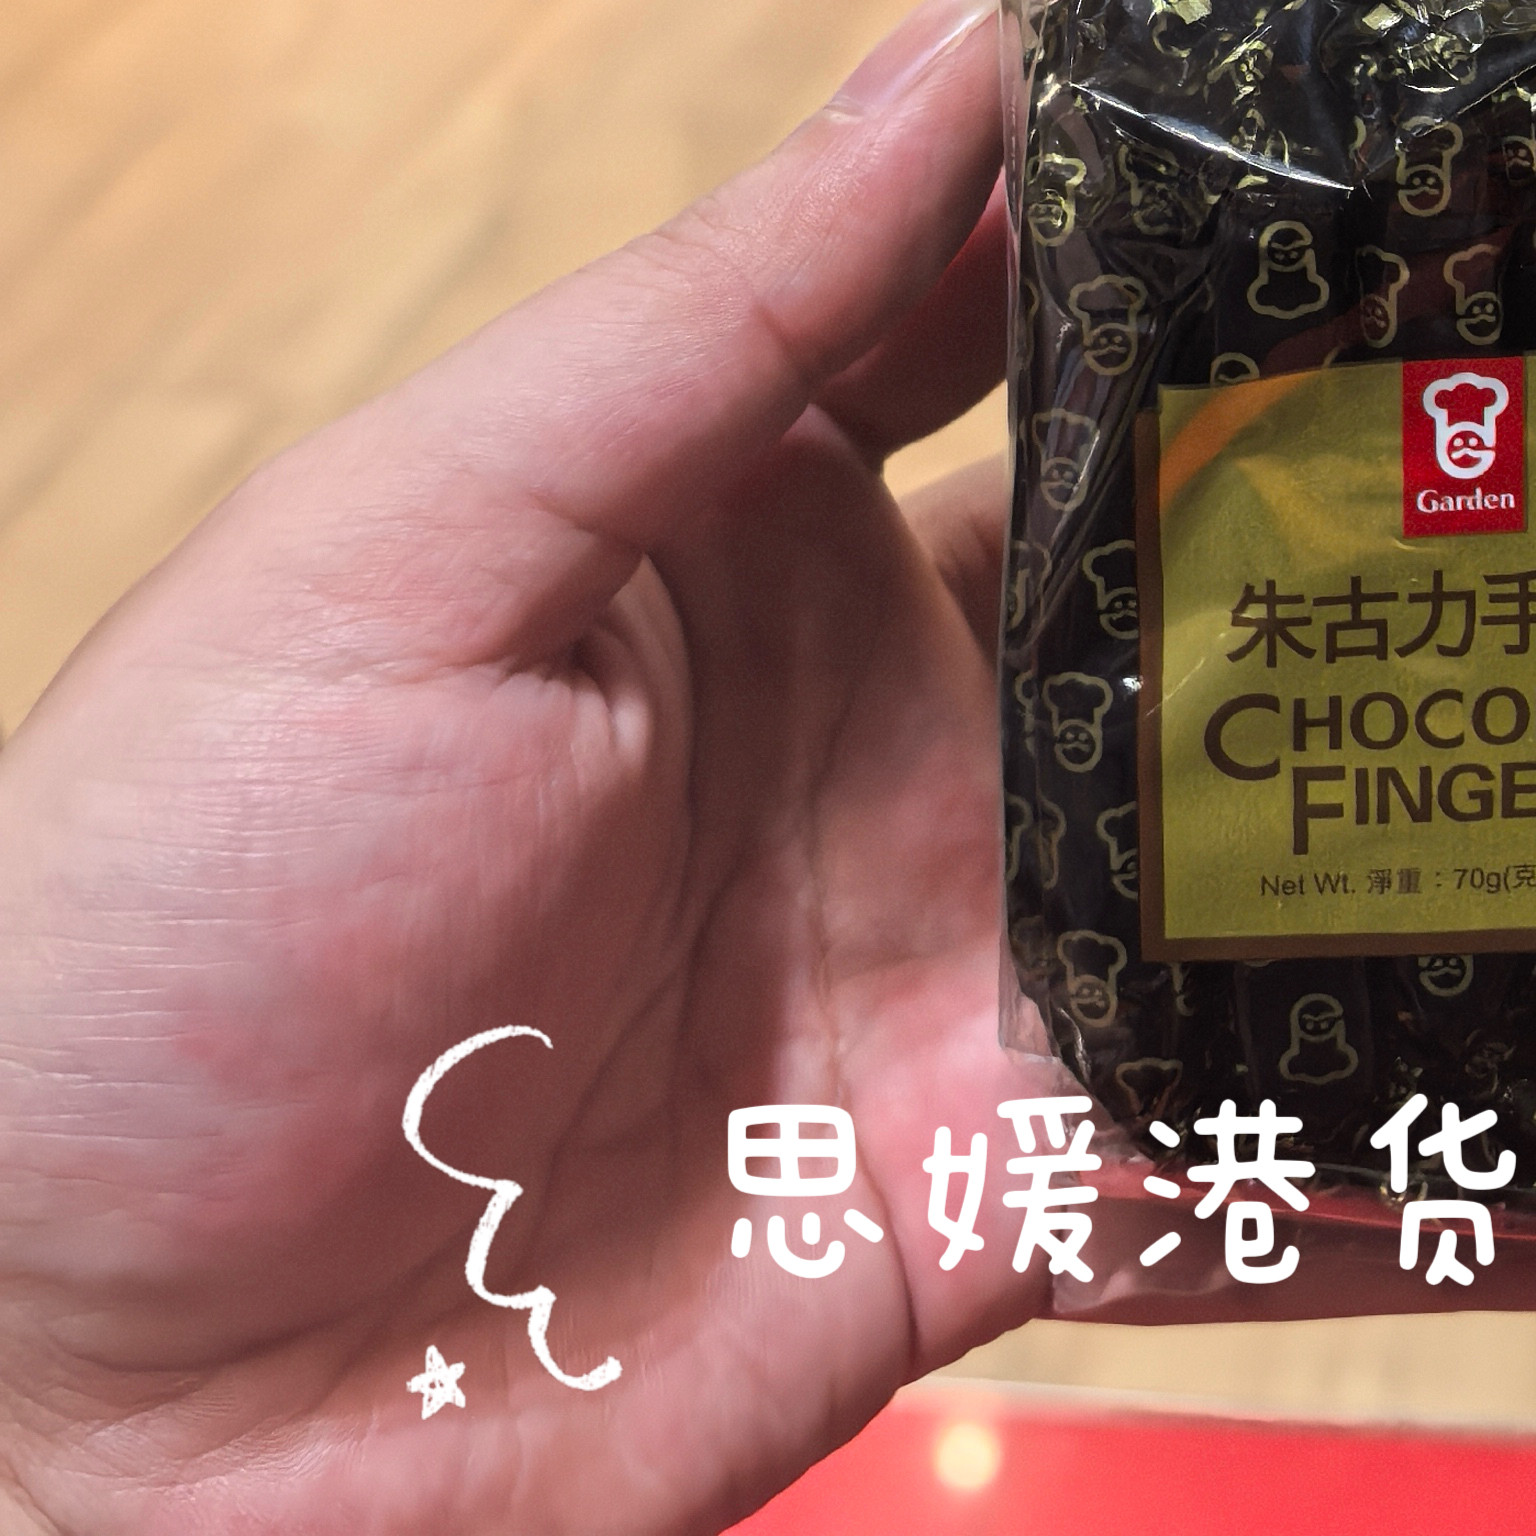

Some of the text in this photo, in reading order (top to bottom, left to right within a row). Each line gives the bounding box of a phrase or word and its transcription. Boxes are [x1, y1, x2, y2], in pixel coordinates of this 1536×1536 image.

[1416, 486, 1516, 514] Garden
[1260, 874, 1304, 897] Net
[1314, 871, 1355, 895] Wt.
